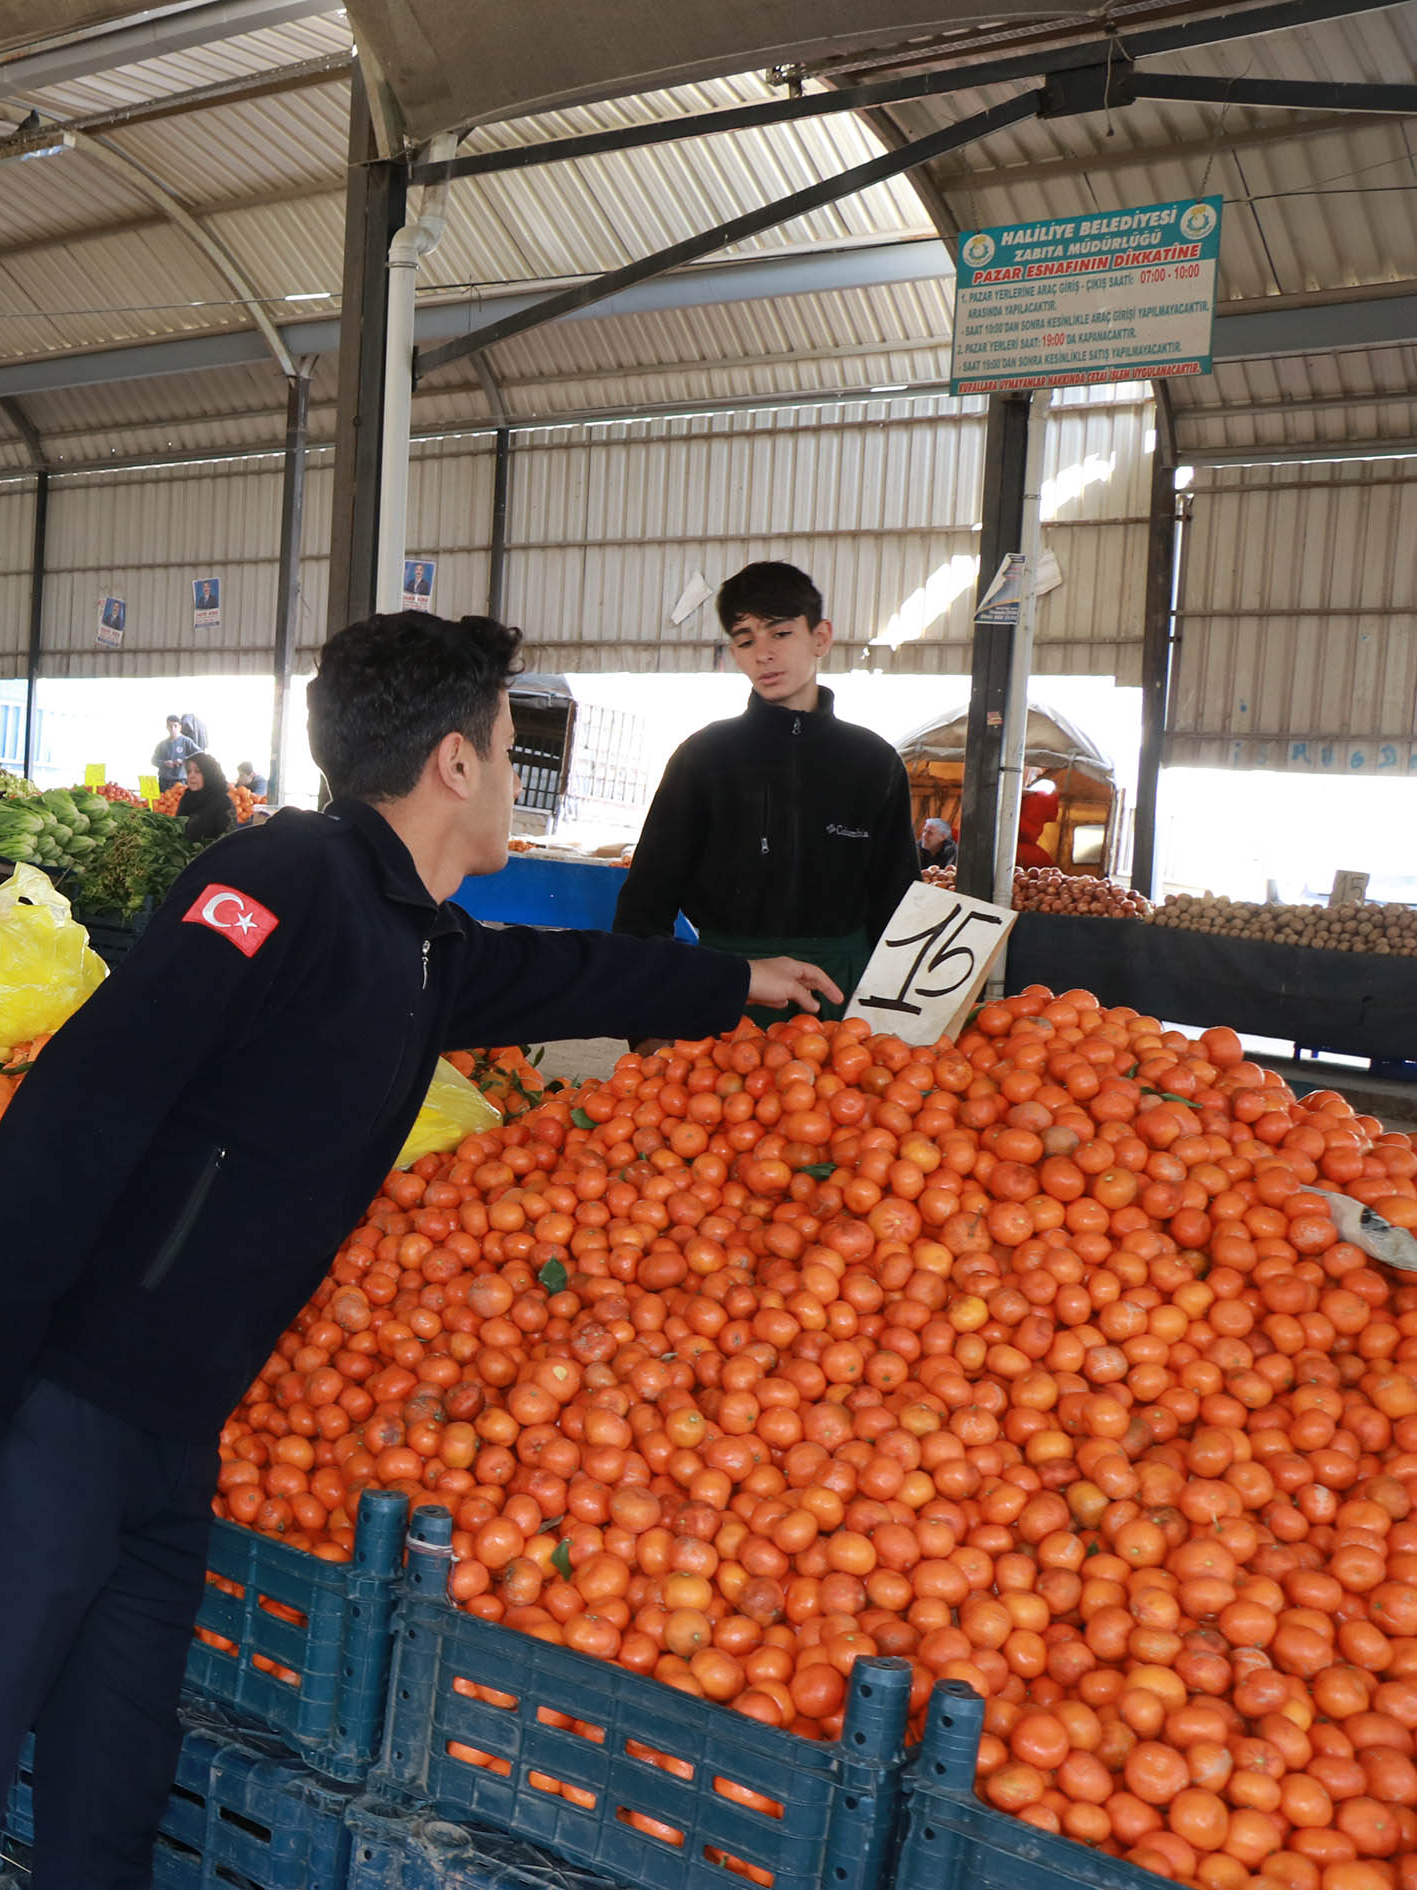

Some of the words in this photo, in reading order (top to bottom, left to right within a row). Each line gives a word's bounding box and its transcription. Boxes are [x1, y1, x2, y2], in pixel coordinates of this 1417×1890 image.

[1001, 225, 1075, 246] HALİLİYE
[1079, 204, 1177, 235] BELEDİYESİ
[1013, 244, 1064, 262] ZABITA
[1067, 228, 1162, 255] MÜDÜRLÜĞÜ
[968, 290, 992, 302] PAZAR
[1140, 268, 1165, 283] 07:00
[1173, 263, 1199, 279] 10:00
[973, 265, 1022, 284] PAZAR
[1026, 254, 1110, 277] ESNAFININ
[1113, 242, 1200, 267] DİKKATİNE
[965, 341, 987, 354] PAZAR
[1042, 331, 1064, 347] 19:00
[858, 903, 1002, 1016] 15
